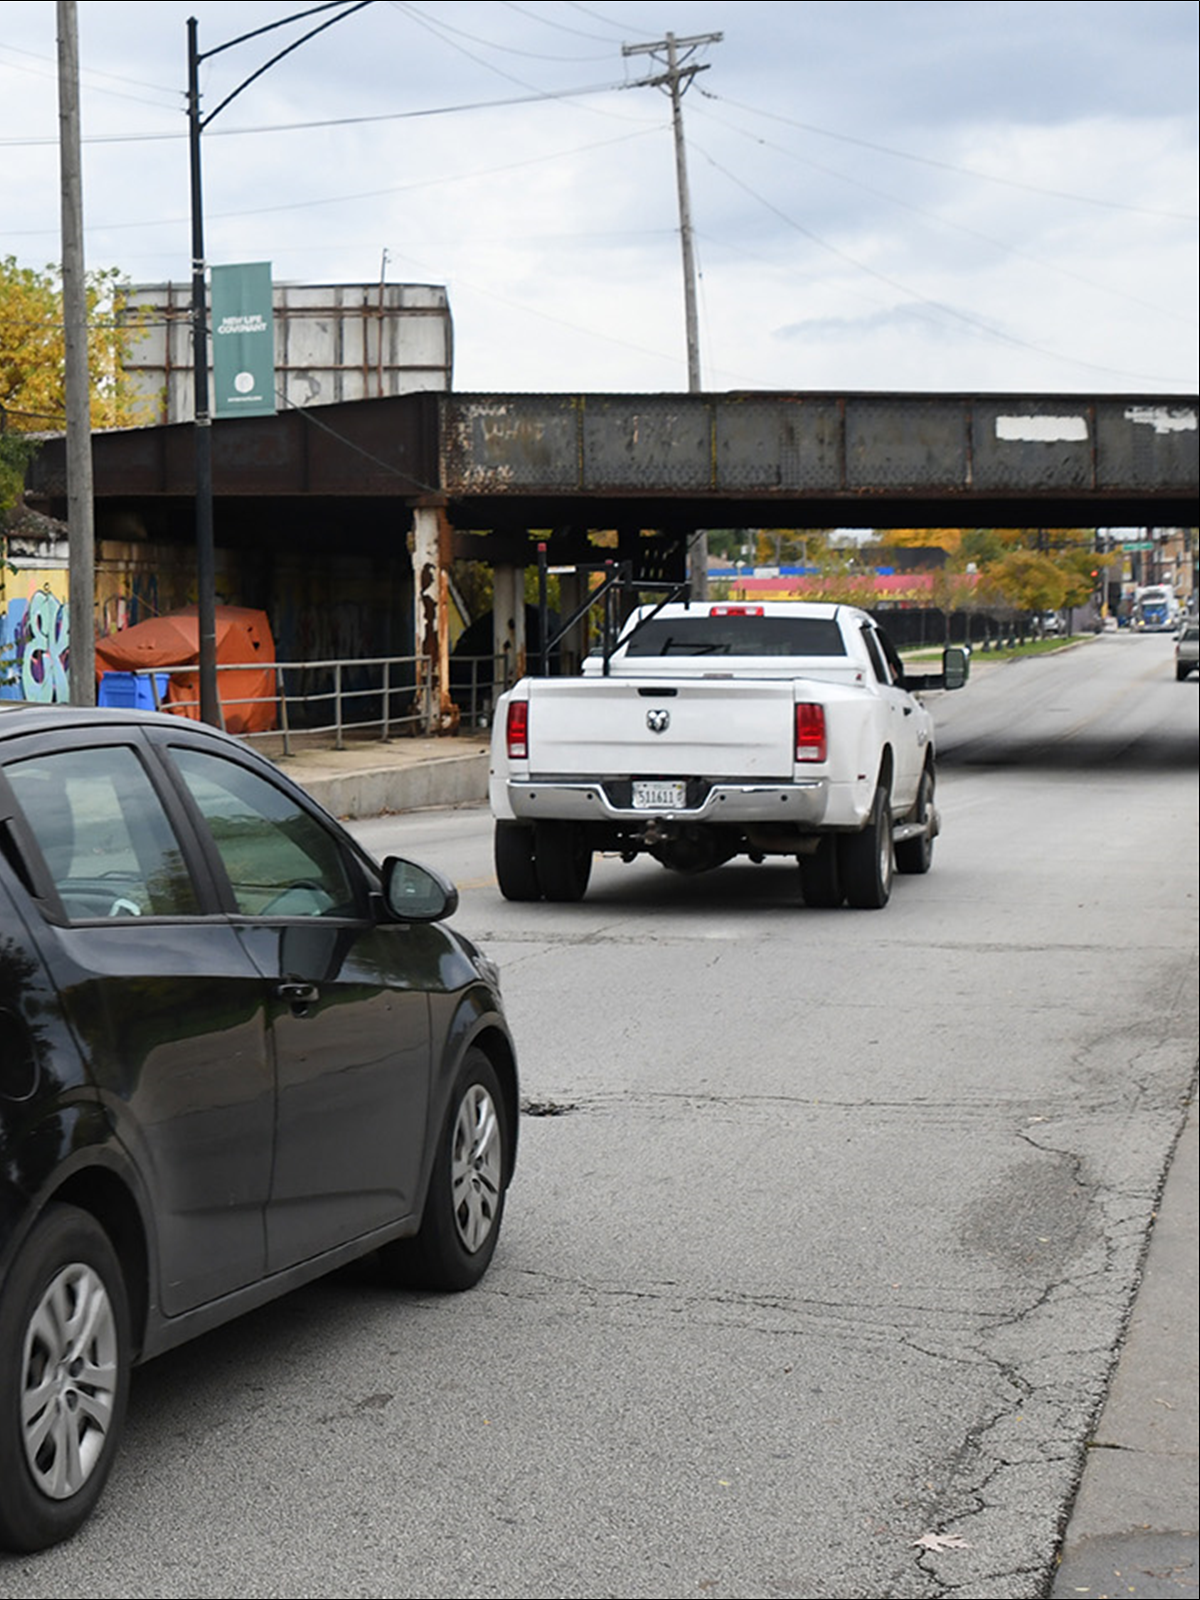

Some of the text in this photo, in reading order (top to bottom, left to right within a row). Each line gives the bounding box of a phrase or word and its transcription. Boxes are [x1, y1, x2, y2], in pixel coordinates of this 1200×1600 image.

[222, 314, 262, 326] NEW LIFE
[217, 322, 267, 334] COVENANT
